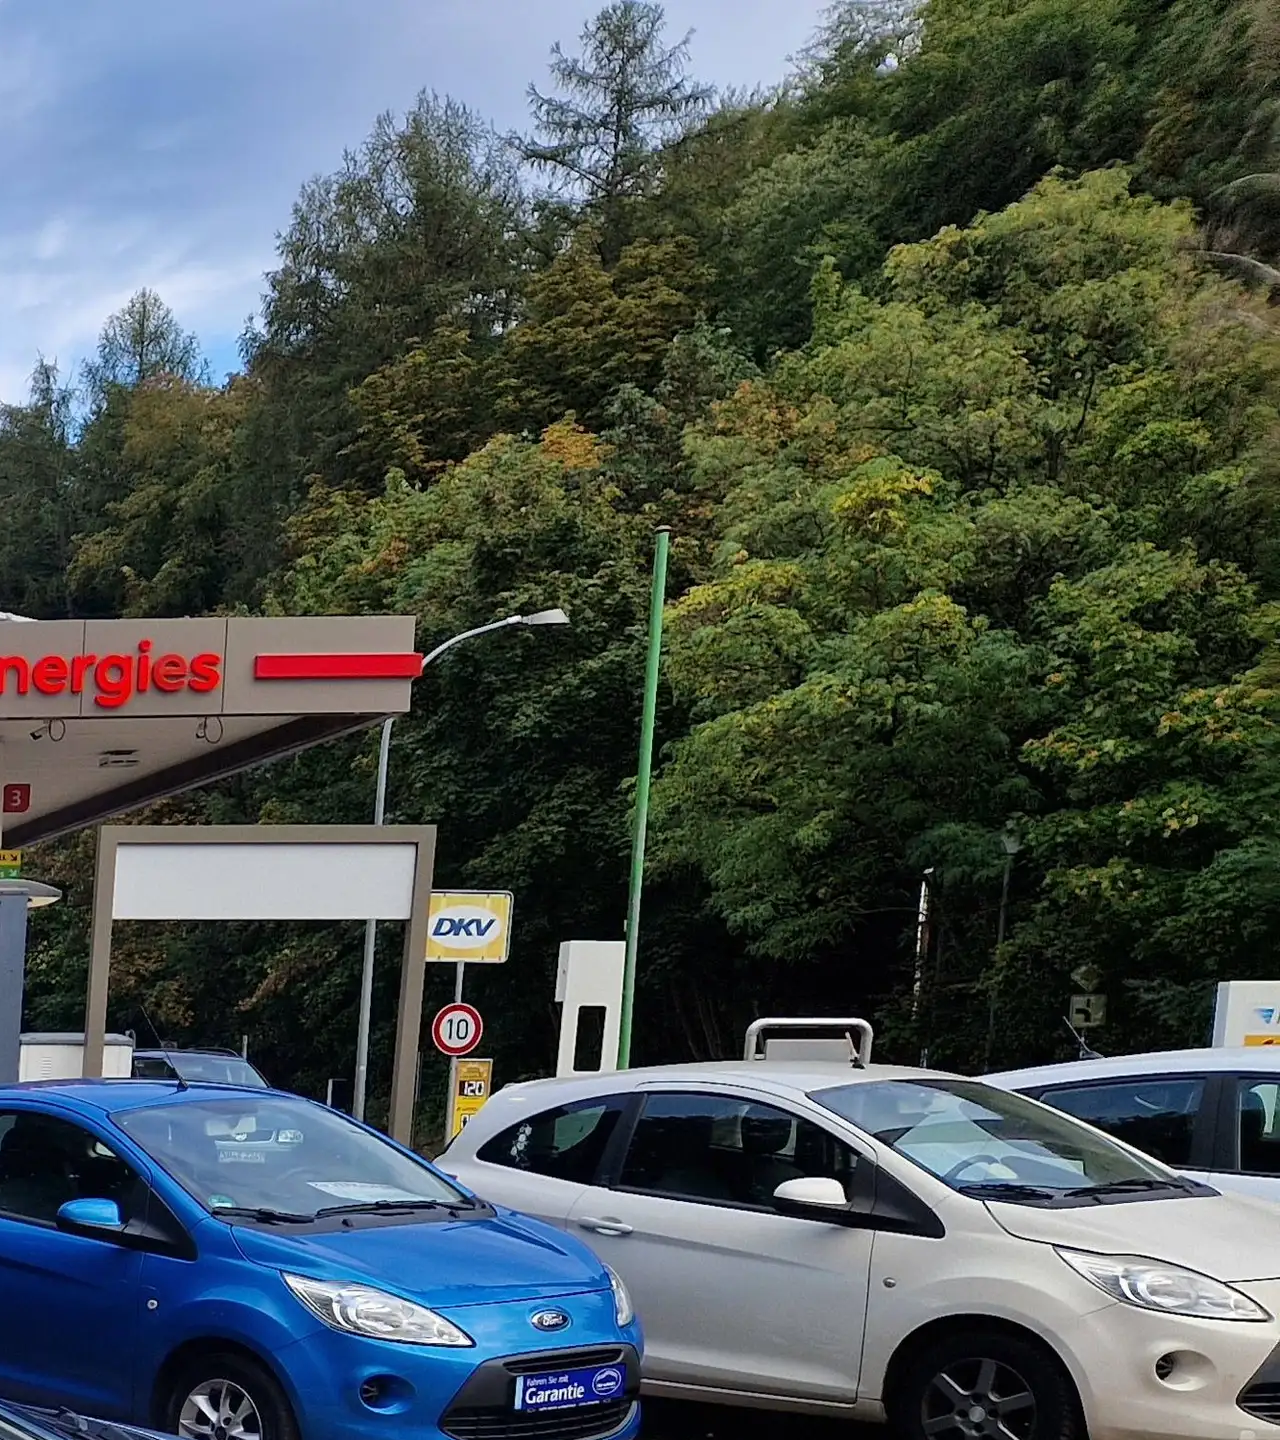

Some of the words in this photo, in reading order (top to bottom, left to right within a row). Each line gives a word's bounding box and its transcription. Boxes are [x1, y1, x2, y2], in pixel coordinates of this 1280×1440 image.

[10, 789, 22, 807] 3
[432, 917, 497, 937] DKV
[447, 1019, 469, 1040] 10
[463, 1081, 485, 1096] 120
[525, 1382, 585, 1404] Garantie
